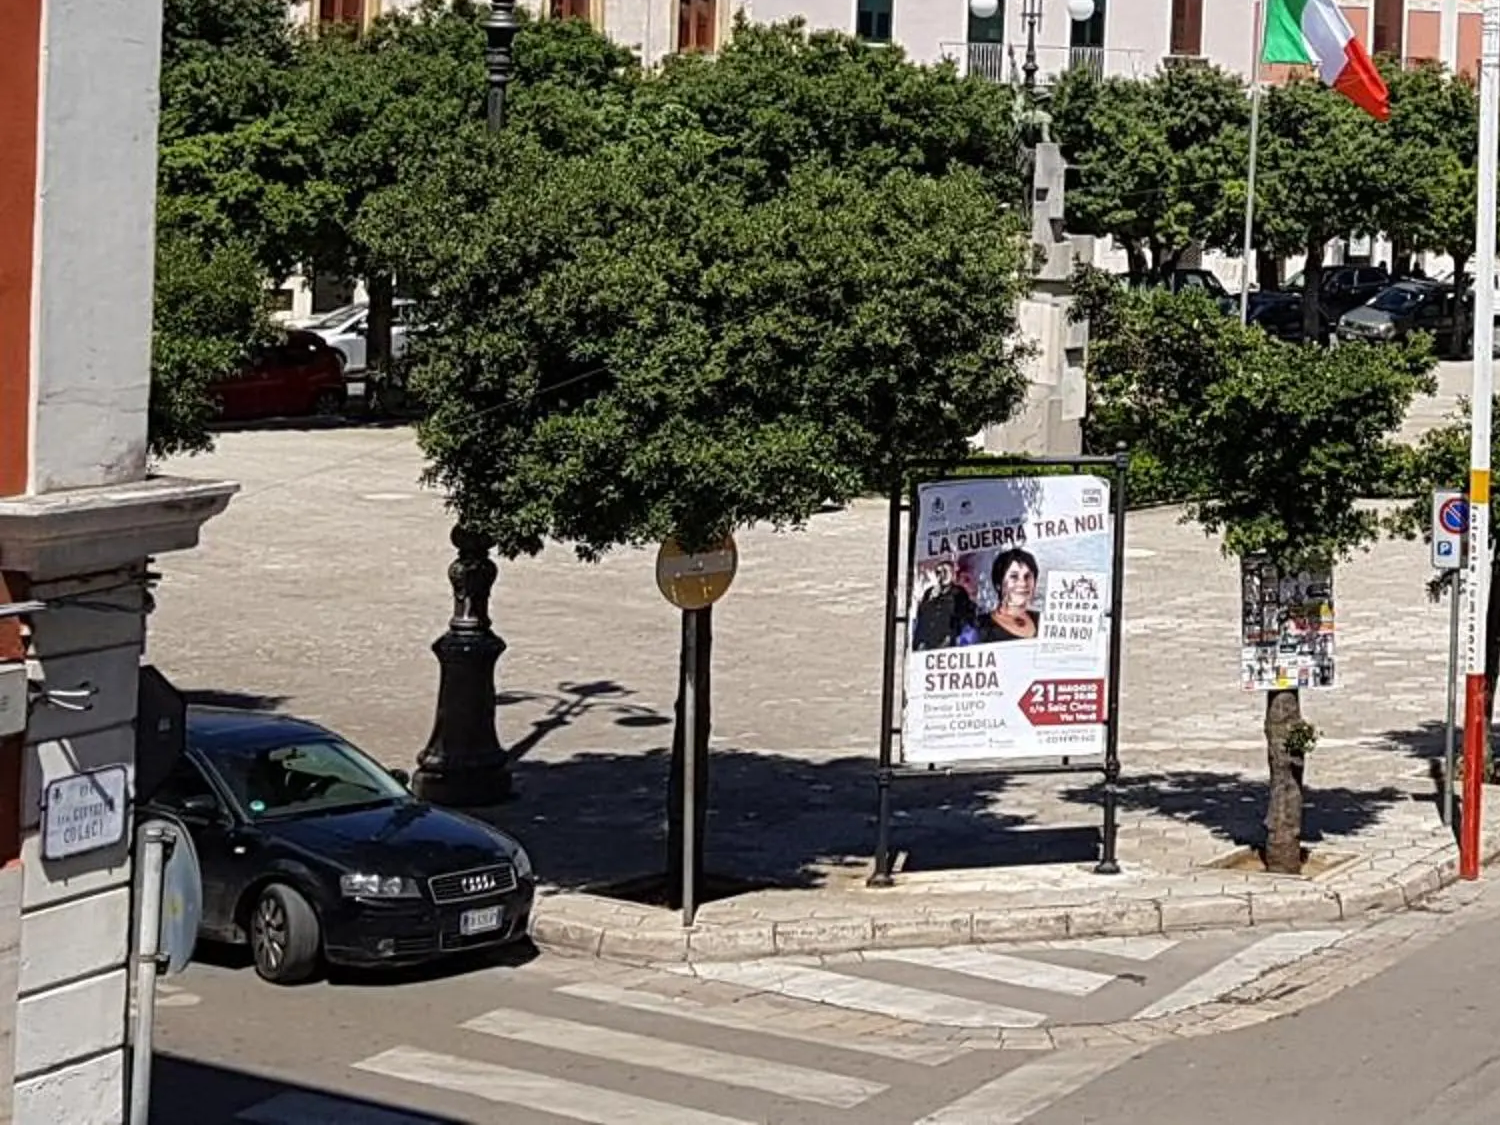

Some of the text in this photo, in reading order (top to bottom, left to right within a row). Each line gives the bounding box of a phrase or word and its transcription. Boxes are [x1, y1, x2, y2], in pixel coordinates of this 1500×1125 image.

[927, 536, 951, 556] LA
[957, 525, 1027, 551] GUERRA
[1033, 518, 1068, 539] TRA
[1075, 513, 1104, 532] NOI
[1043, 624, 1093, 641] TRA NOI
[925, 651, 997, 670] CECILIA
[924, 670, 999, 692] STRADA
[1031, 683, 1055, 703] 21
